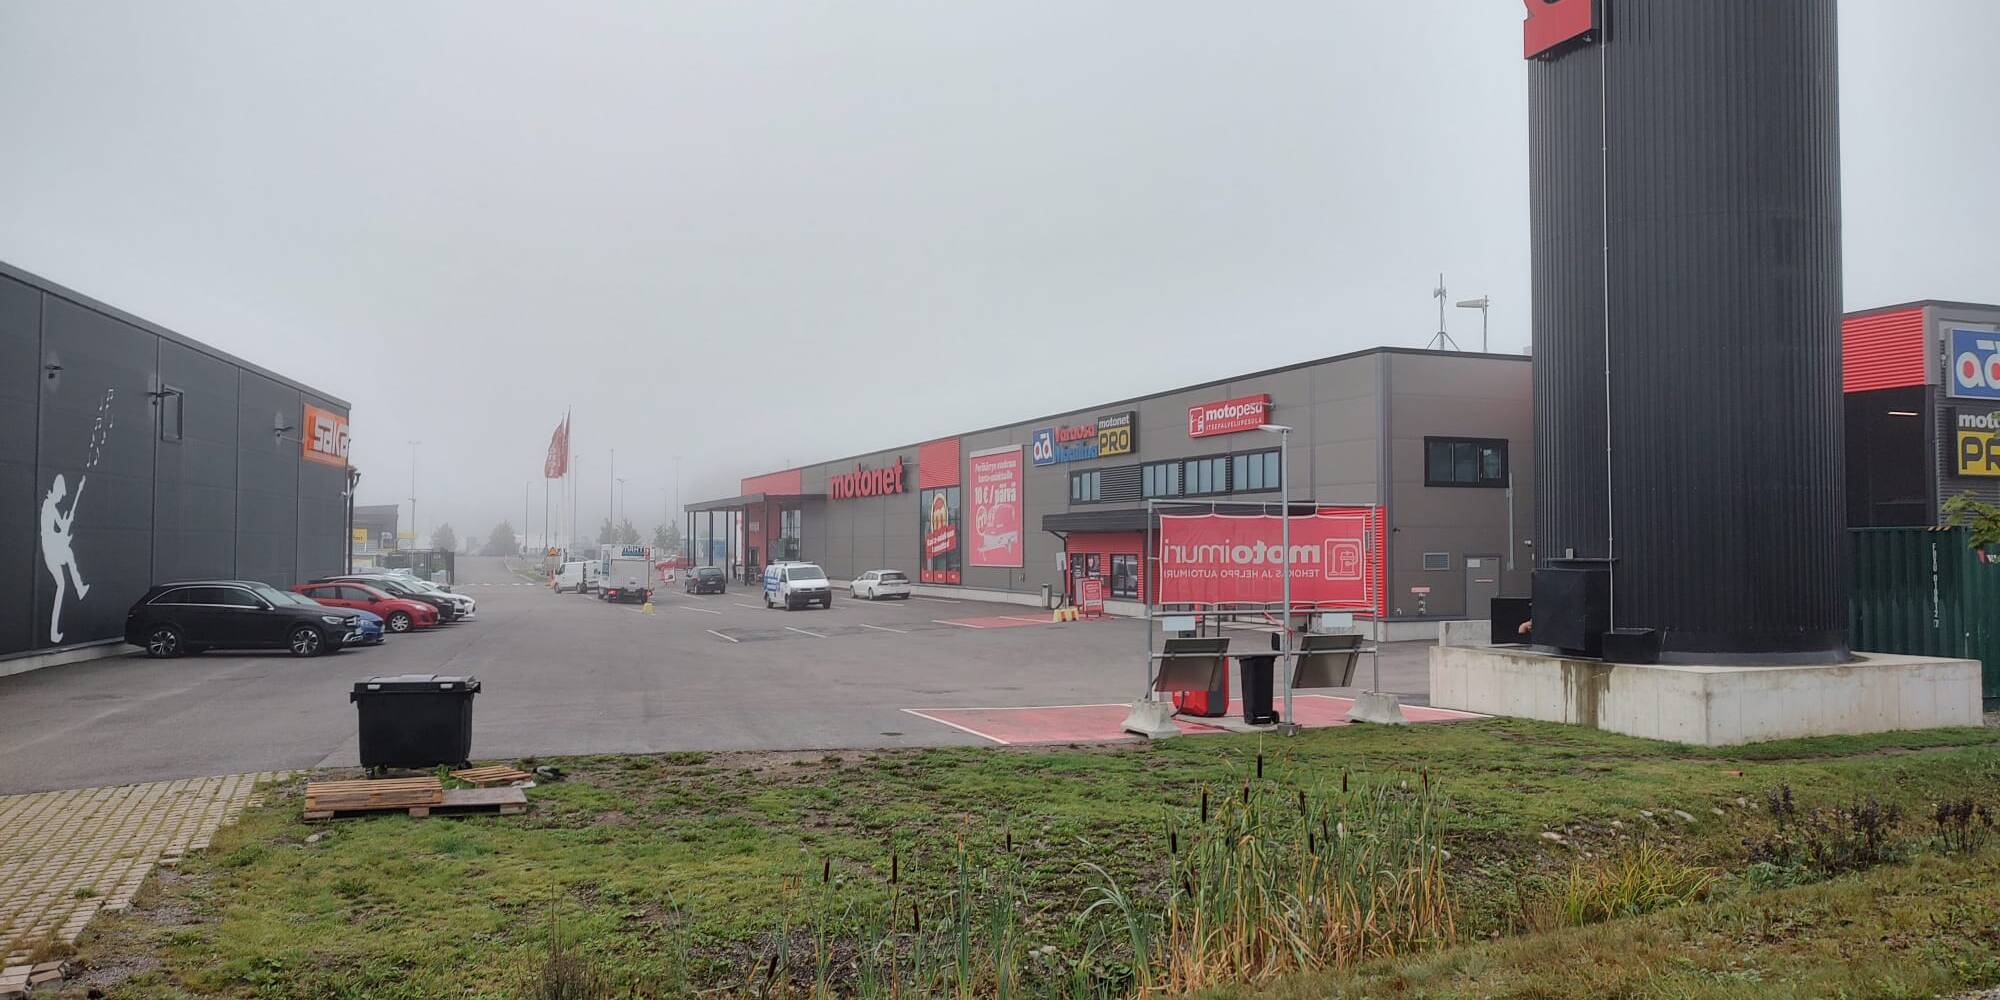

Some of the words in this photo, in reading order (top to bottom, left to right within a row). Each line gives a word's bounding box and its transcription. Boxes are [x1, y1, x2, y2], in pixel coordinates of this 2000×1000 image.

[1099, 414, 1130, 428] motonet
[1205, 401, 1263, 421] motopesu
[1100, 430, 1129, 454] PRO
[831, 456, 903, 499] motonet
